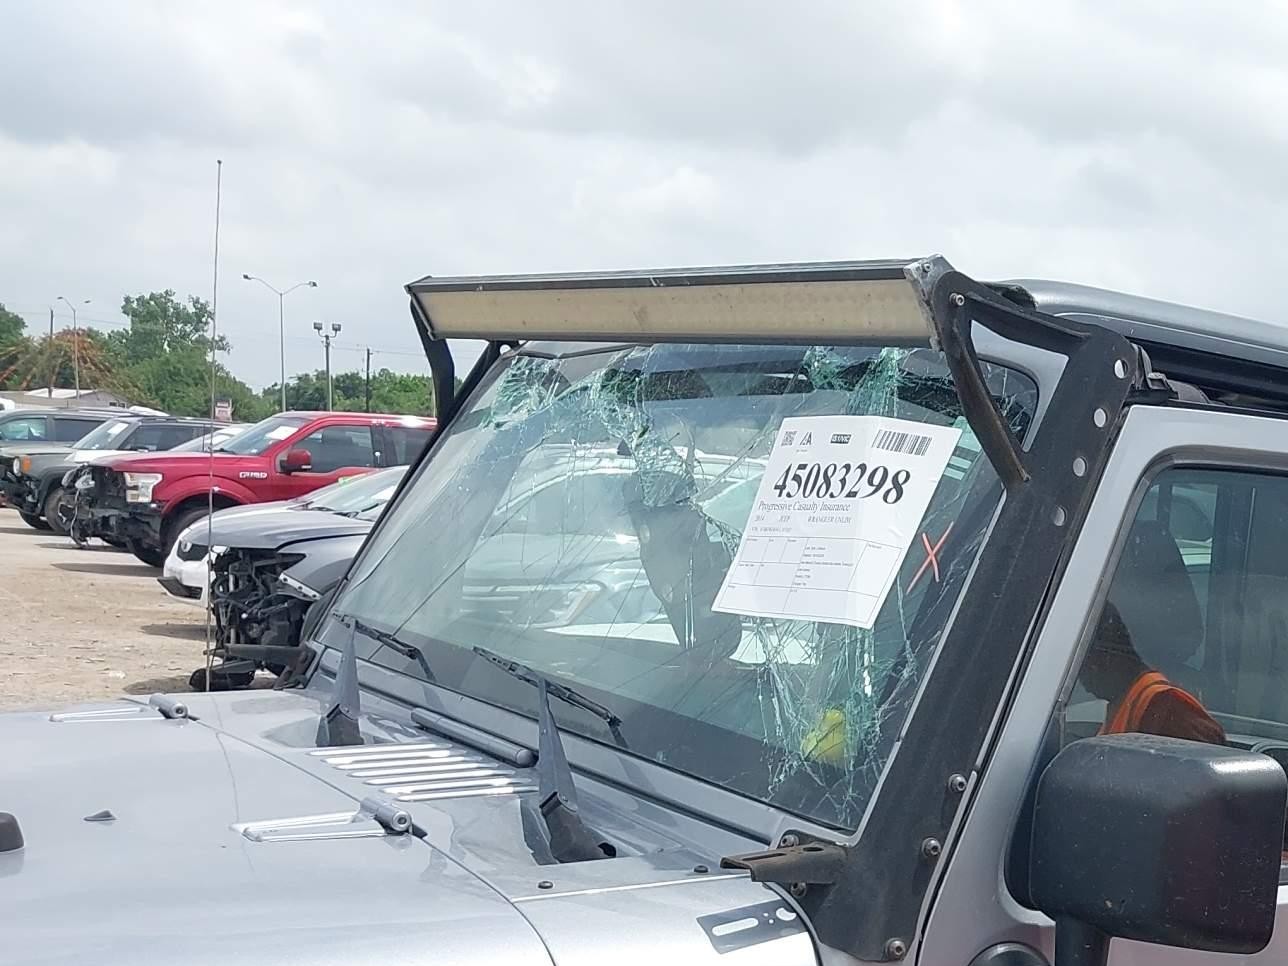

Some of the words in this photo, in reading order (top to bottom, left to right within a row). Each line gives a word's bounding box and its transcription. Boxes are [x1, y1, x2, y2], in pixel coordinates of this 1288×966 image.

[773, 462, 911, 505] 45083298
[758, 500, 792, 512] Progressive
[793, 500, 819, 513] Casualty
[819, 501, 851, 512] Insurance
